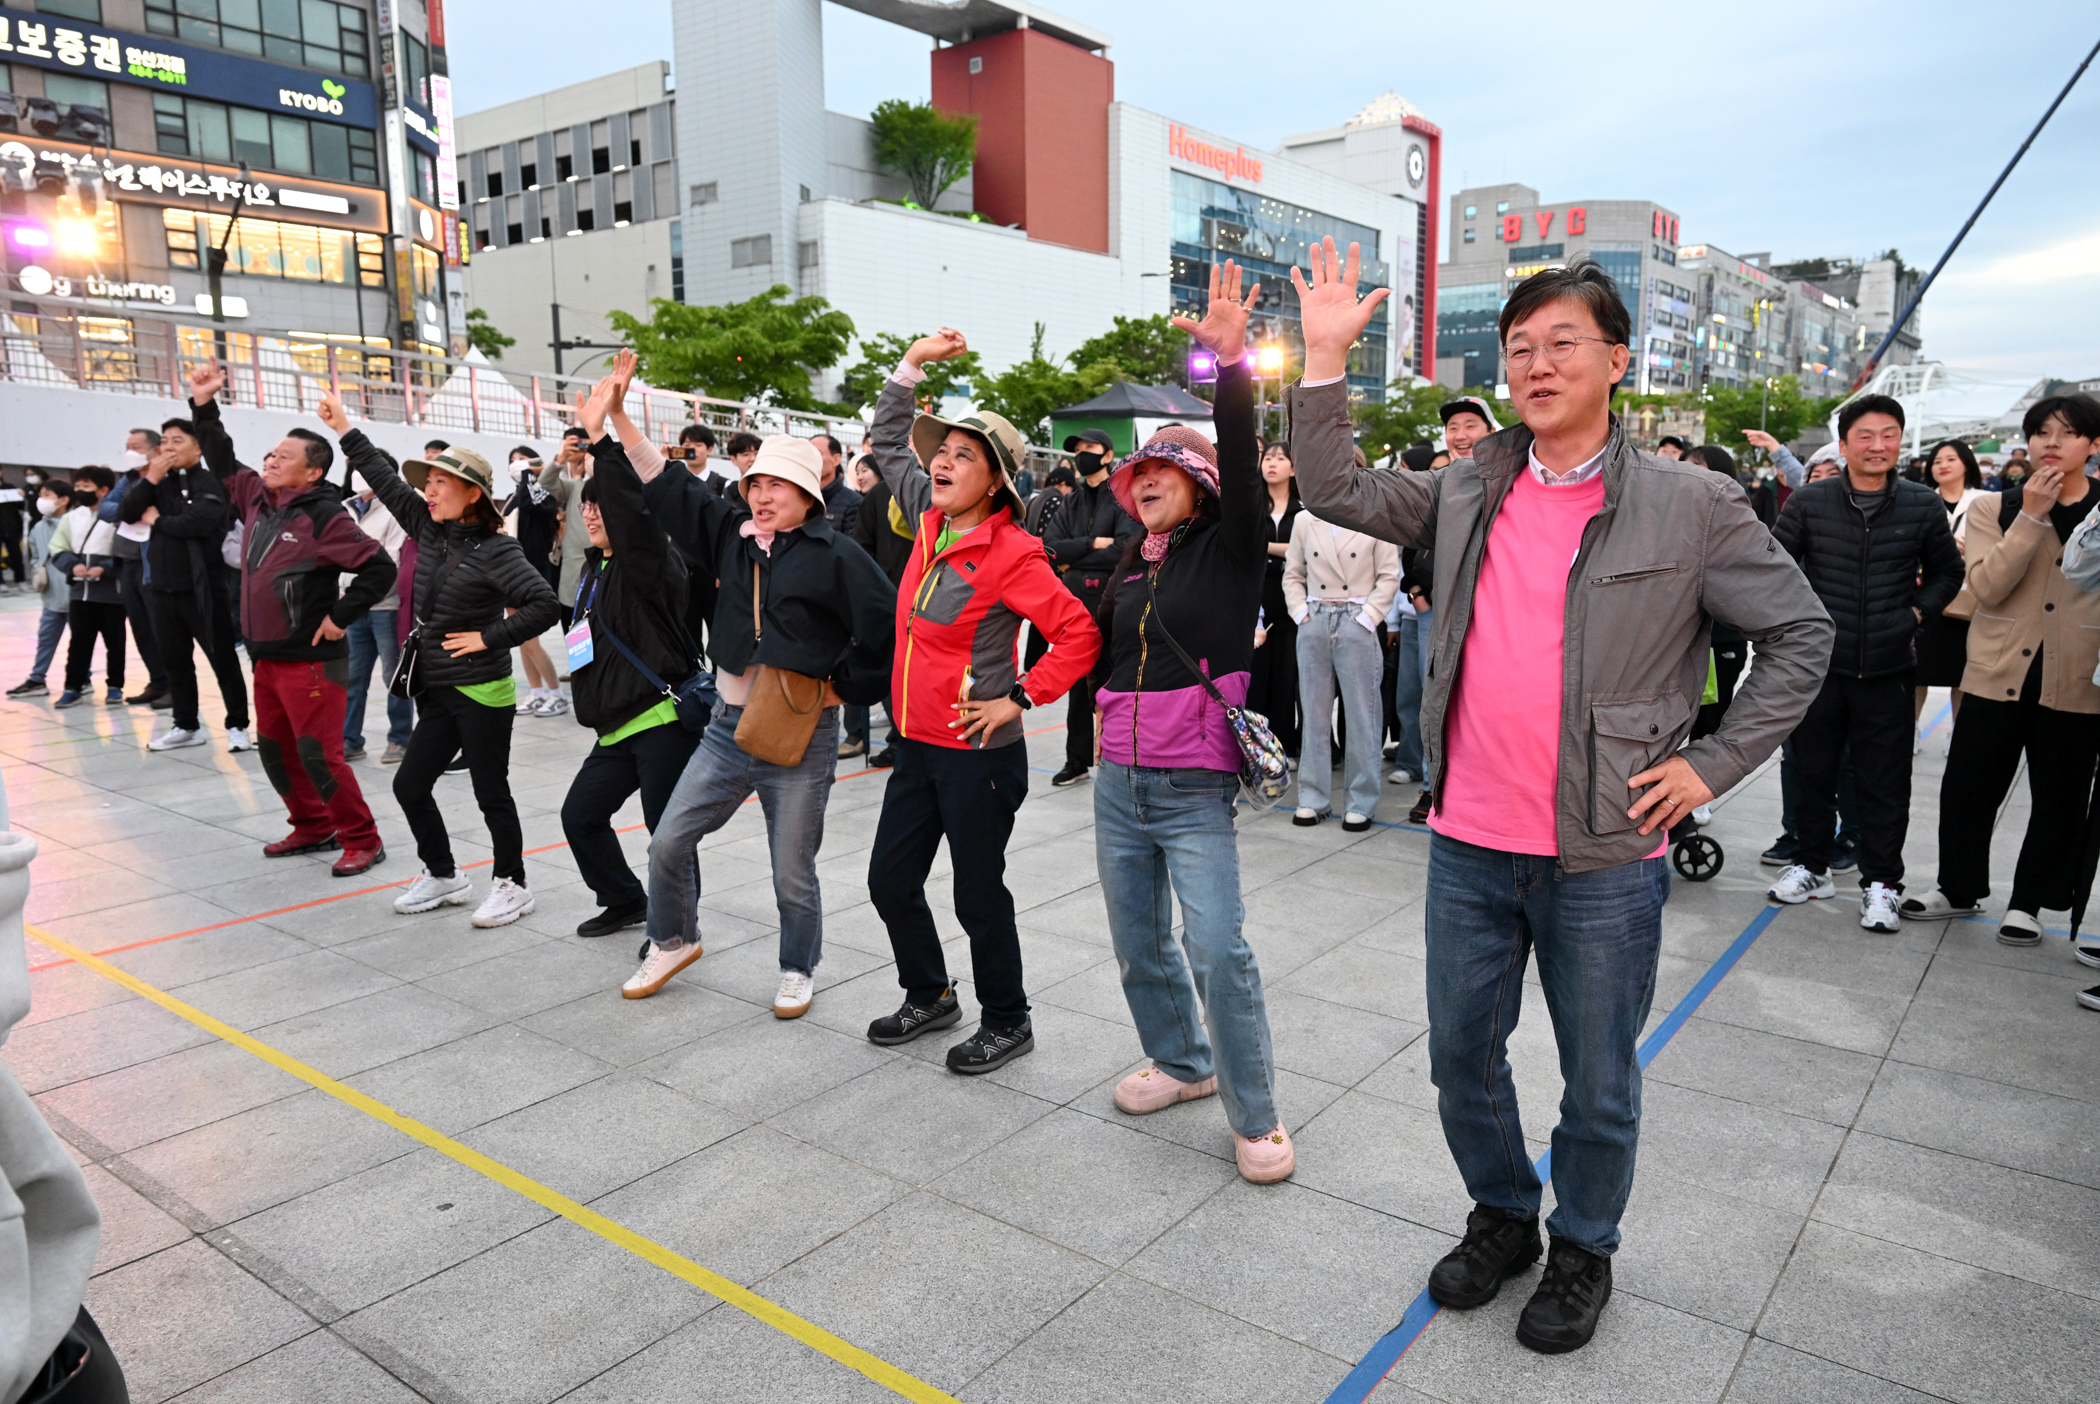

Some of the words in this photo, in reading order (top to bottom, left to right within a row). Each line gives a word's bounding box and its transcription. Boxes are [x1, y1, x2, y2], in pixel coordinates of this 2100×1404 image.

[279, 88, 344, 116] KYOBO
[1169, 123, 1263, 183] Homeplus
[1503, 207, 1586, 242] BYC
